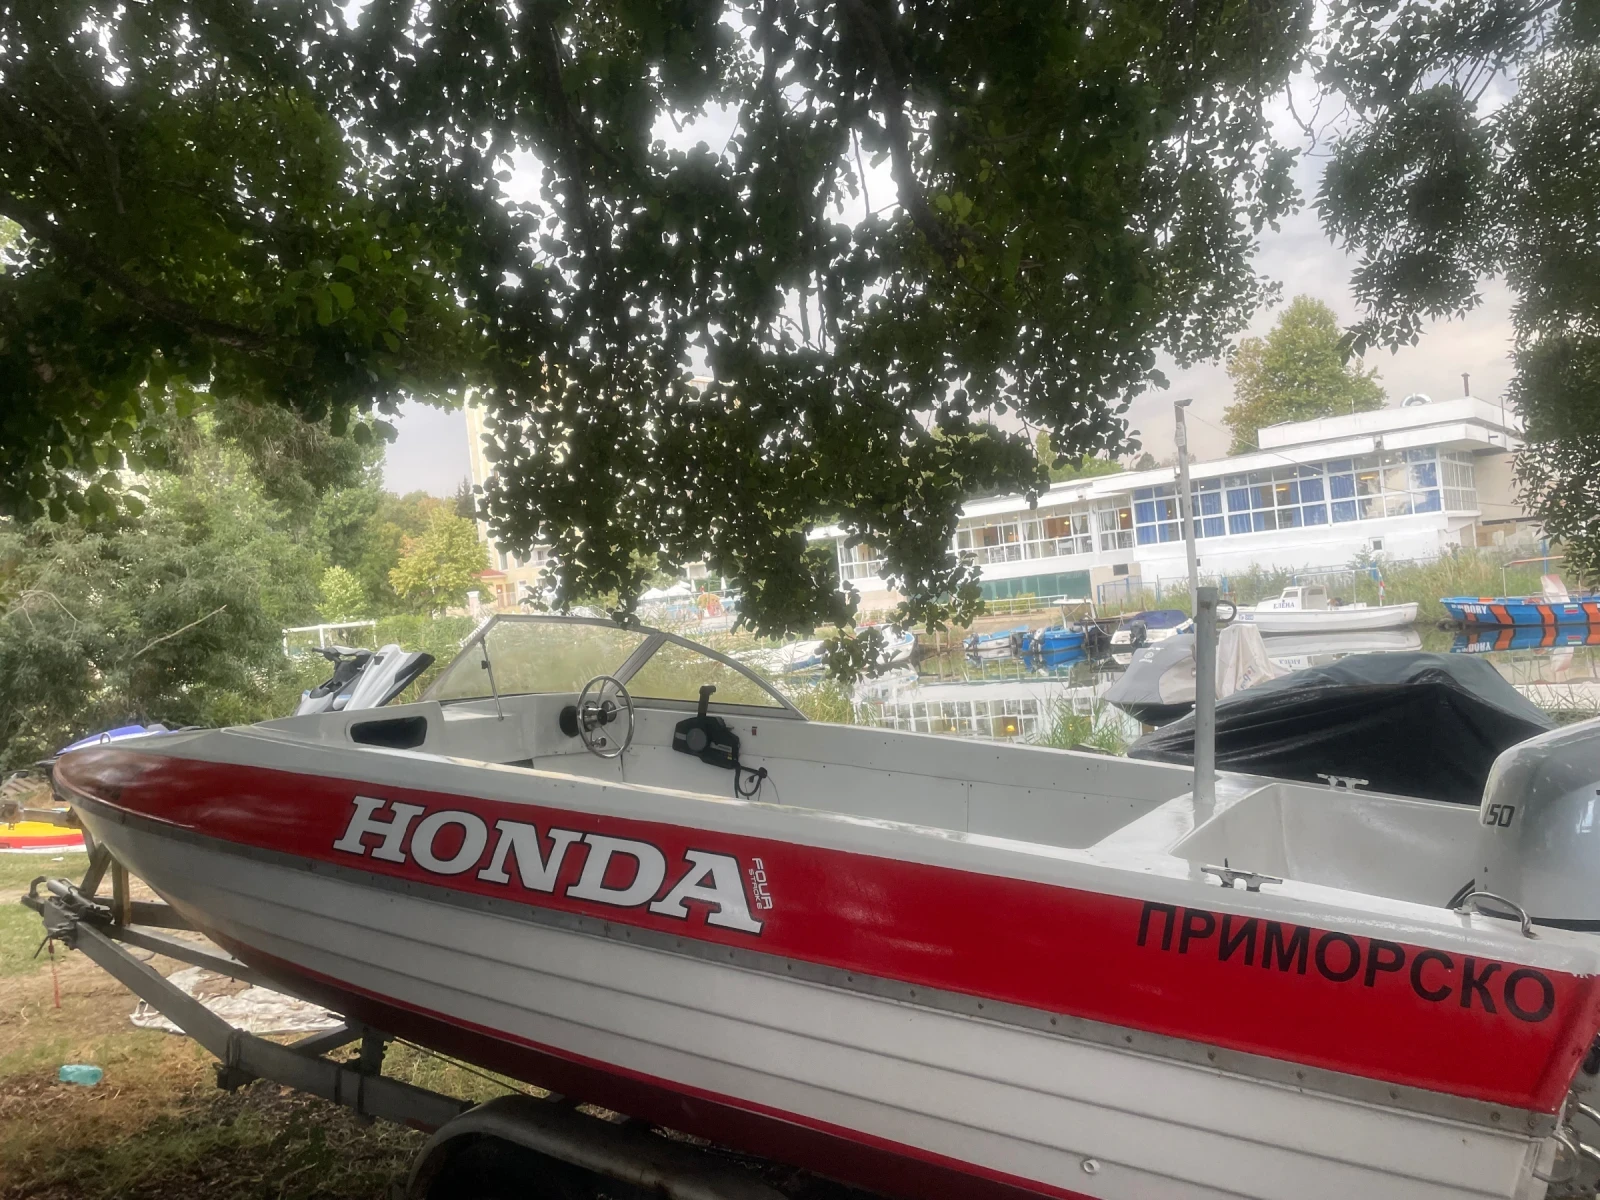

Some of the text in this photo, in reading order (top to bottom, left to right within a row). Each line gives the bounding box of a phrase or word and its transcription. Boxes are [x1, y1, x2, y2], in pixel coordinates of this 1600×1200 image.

[1463, 604, 1487, 615] DORY
[332, 795, 764, 936] HONDA
[748, 868, 763, 910] STROKE
[751, 857, 774, 910] FOUR
[1136, 901, 1555, 1023] ПРИМОРСКО
